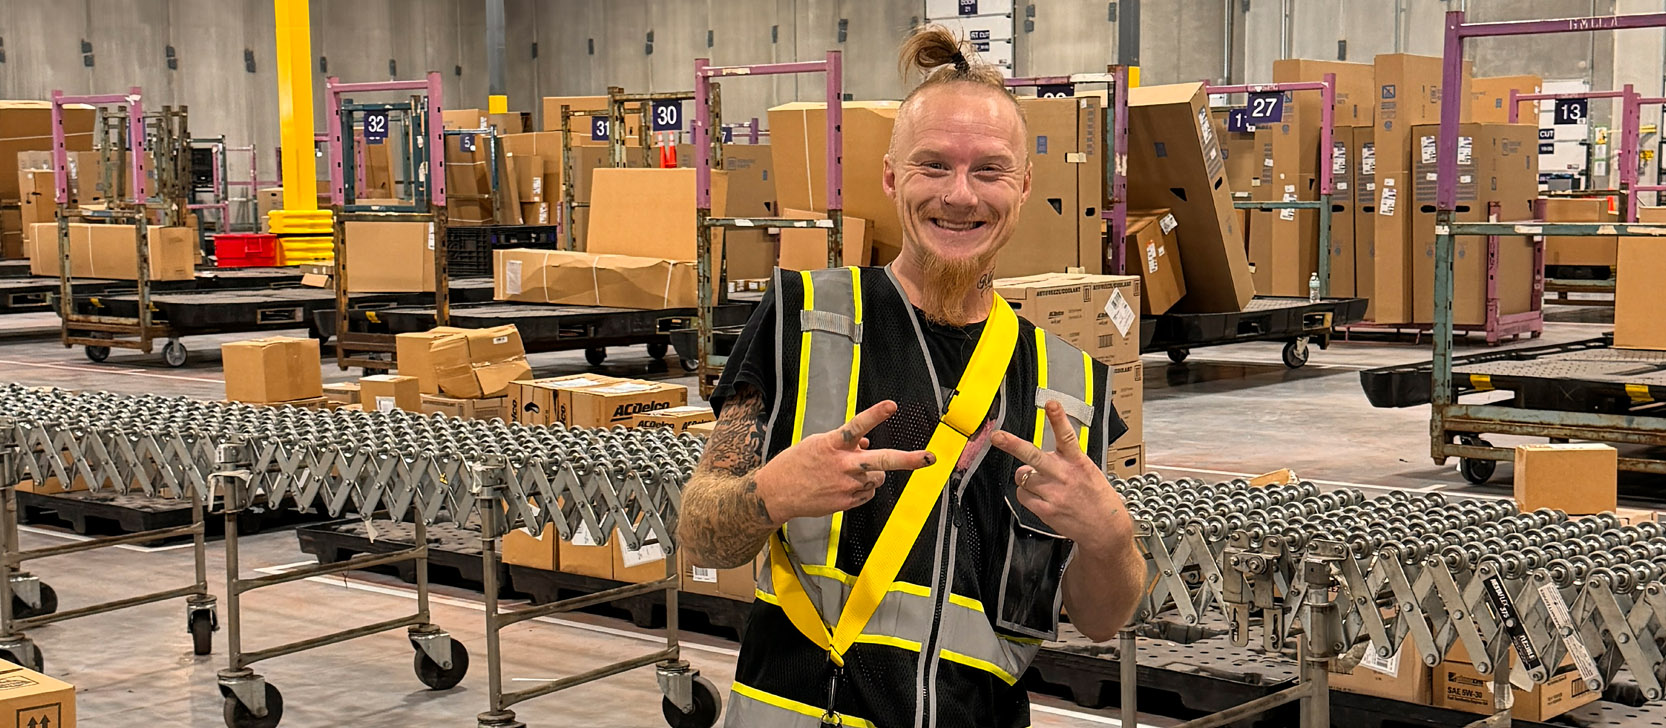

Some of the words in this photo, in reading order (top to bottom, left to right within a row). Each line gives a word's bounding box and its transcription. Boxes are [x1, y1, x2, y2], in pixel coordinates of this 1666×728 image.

[657, 105, 677, 125] 30
[1252, 98, 1278, 117] 27
[1561, 104, 1580, 120] 13
[368, 116, 385, 132] 32
[596, 120, 610, 136] 31
[1539, 129, 1554, 138] CUT
[464, 136, 471, 148] 5
[613, 401, 670, 417] ACDelco
[637, 420, 675, 430] ACDelco
[1448, 686, 1461, 696] SAE
[1462, 688, 1483, 698] 5W-30
